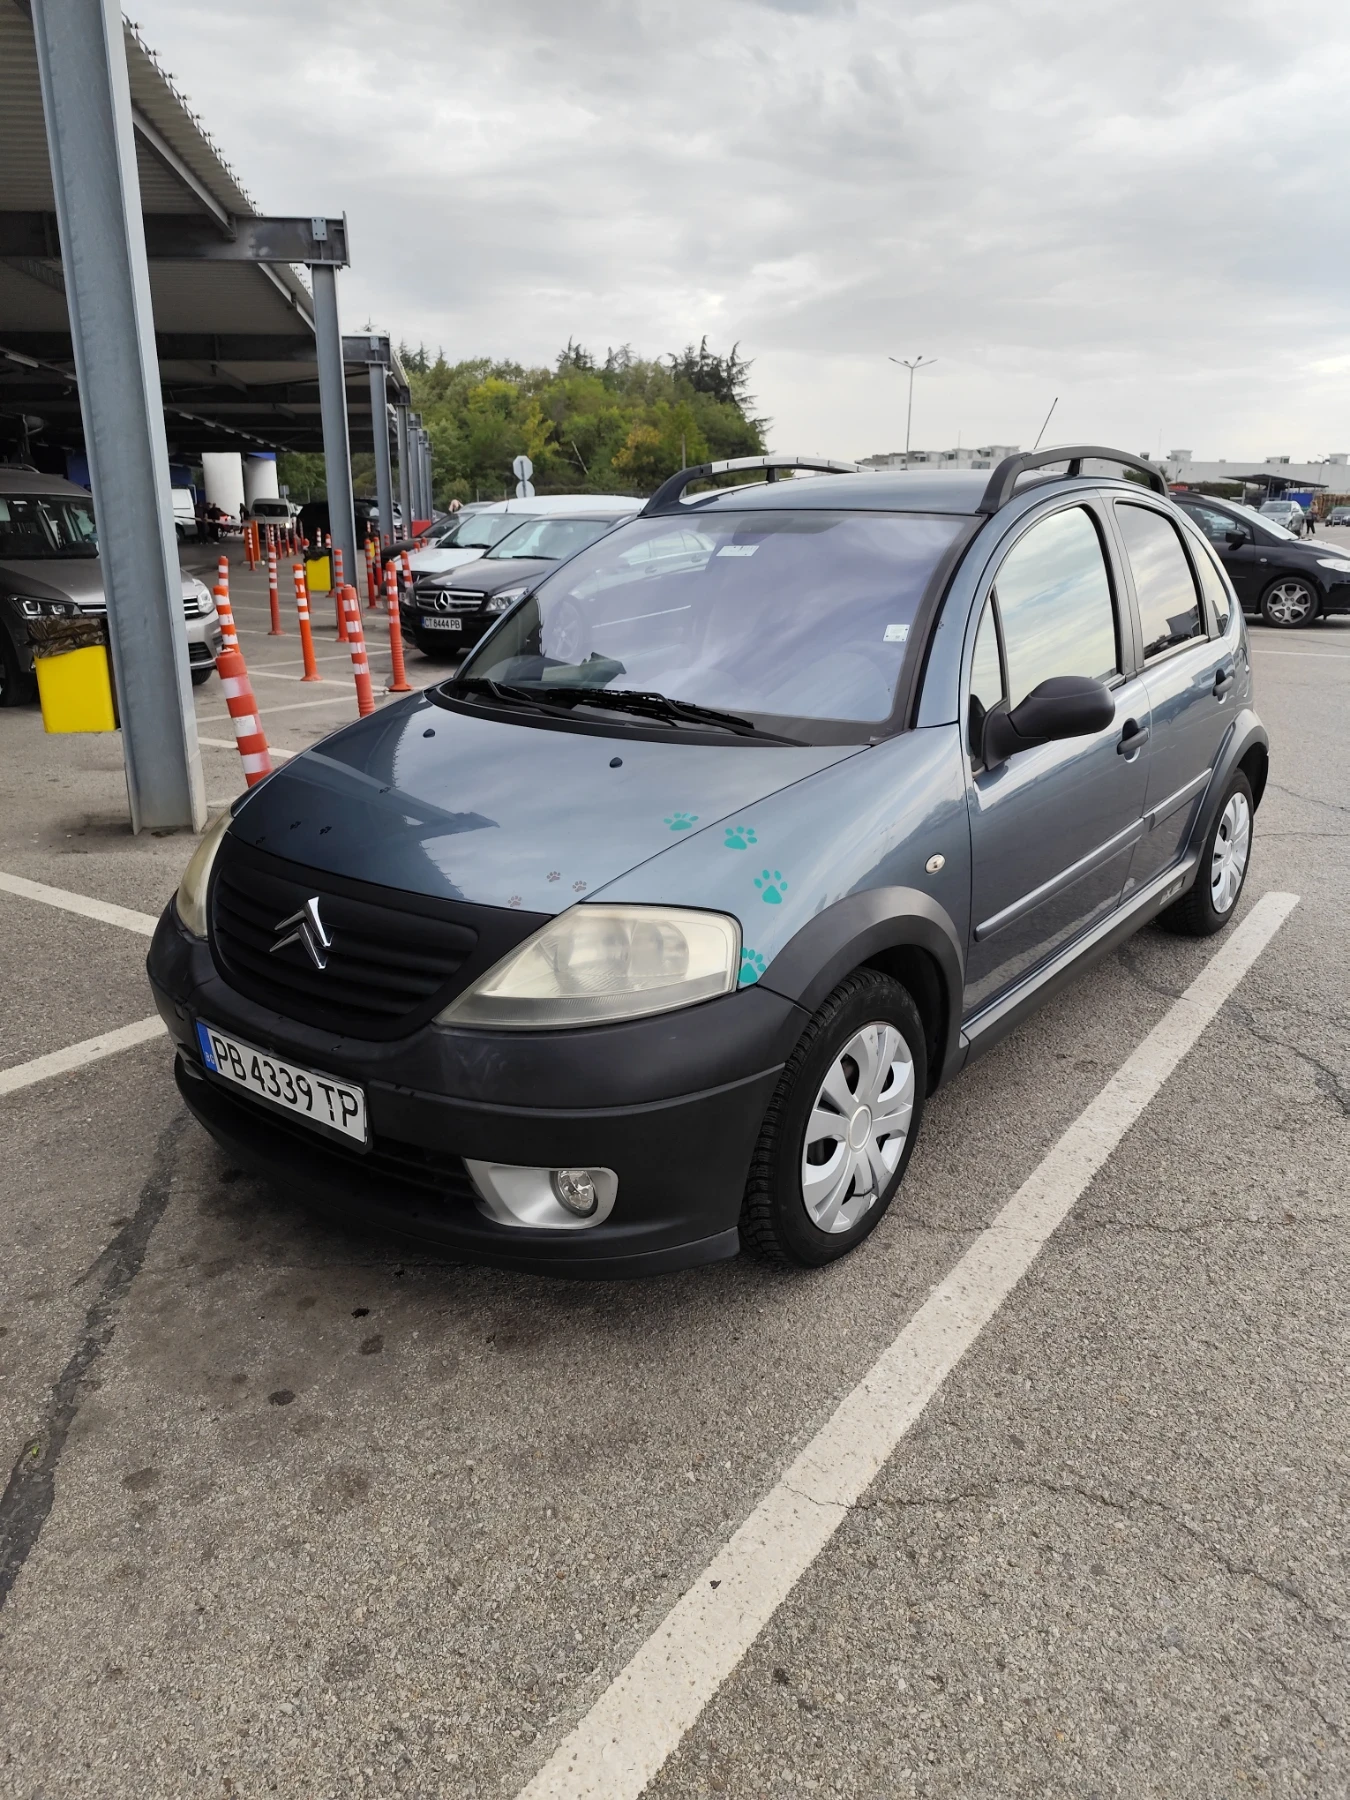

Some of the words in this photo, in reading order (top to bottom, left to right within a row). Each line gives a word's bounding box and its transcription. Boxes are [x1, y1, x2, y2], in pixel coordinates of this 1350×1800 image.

[450, 619, 460, 629] PB
[211, 1035, 247, 1081] PB
[251, 1055, 313, 1111] 4339
[316, 1081, 358, 1127] TP
